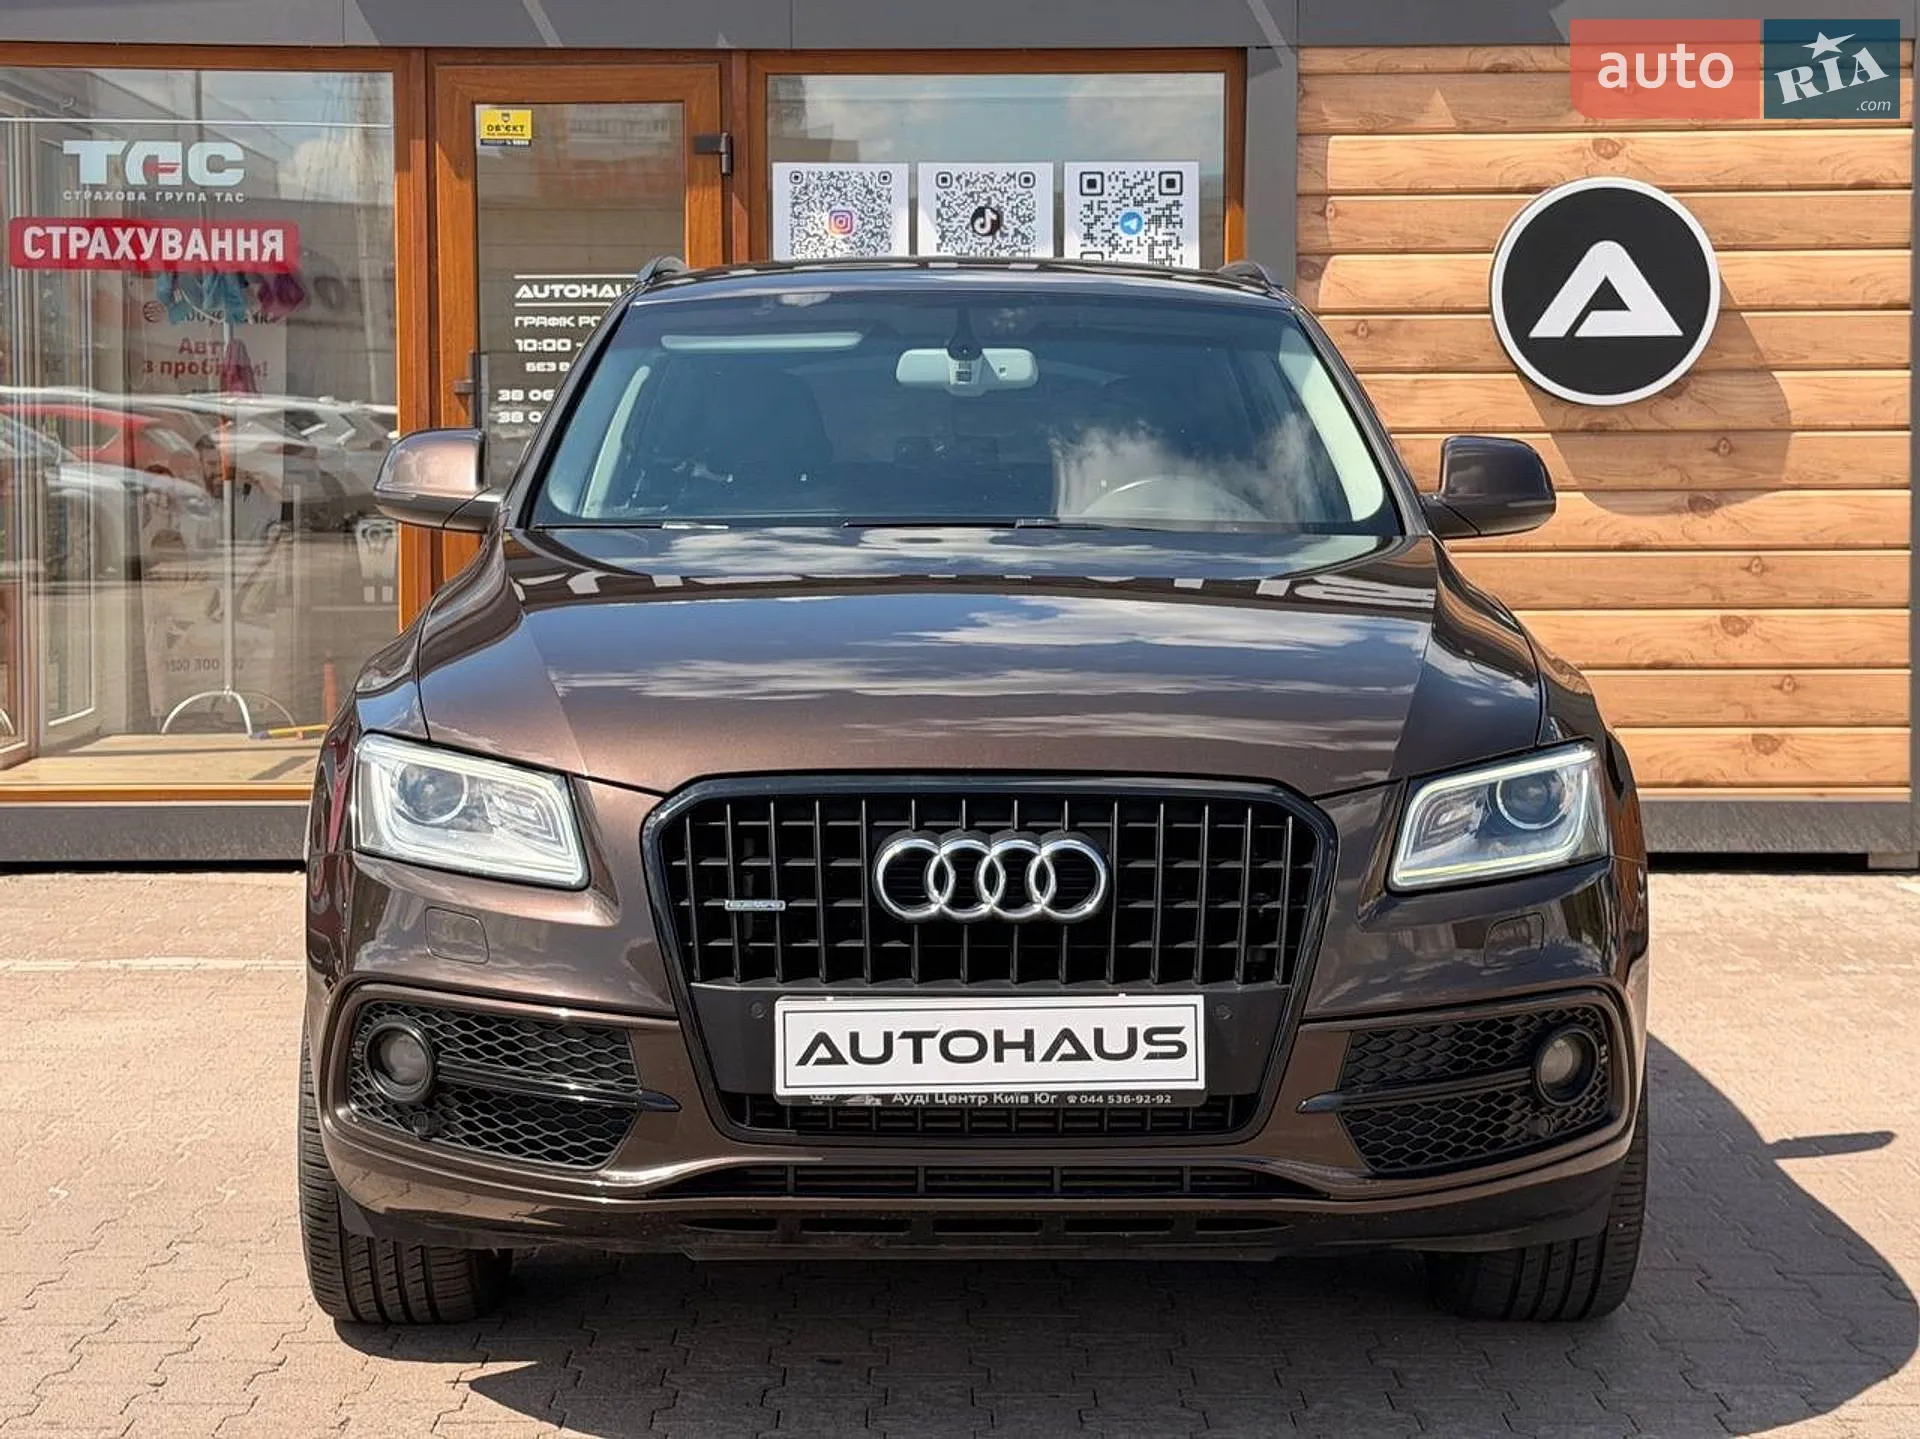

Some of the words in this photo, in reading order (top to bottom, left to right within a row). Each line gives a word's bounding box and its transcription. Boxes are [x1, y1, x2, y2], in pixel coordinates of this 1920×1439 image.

[62, 190, 147, 202] СТРАХОВА
[155, 192, 207, 203] ГРУПА
[214, 192, 244, 203] ТАС
[23, 226, 284, 262] СТРАХУВАННЯ
[515, 284, 631, 298] AUTOHAU
[514, 339, 571, 352] 10:00
[525, 361, 556, 372] БЕЗ
[498, 389, 524, 401] 38
[528, 389, 555, 401] 06
[498, 411, 524, 423] 38
[528, 411, 542, 423] 0
[795, 1025, 1188, 1067] AUTOHAUS
[935, 1092, 988, 1106] Центр
[993, 1092, 1030, 1104] Київ
[1034, 1092, 1057, 1104] Юг
[1079, 1094, 1104, 1104] 044
[1107, 1094, 1172, 1104] 536-92-92
